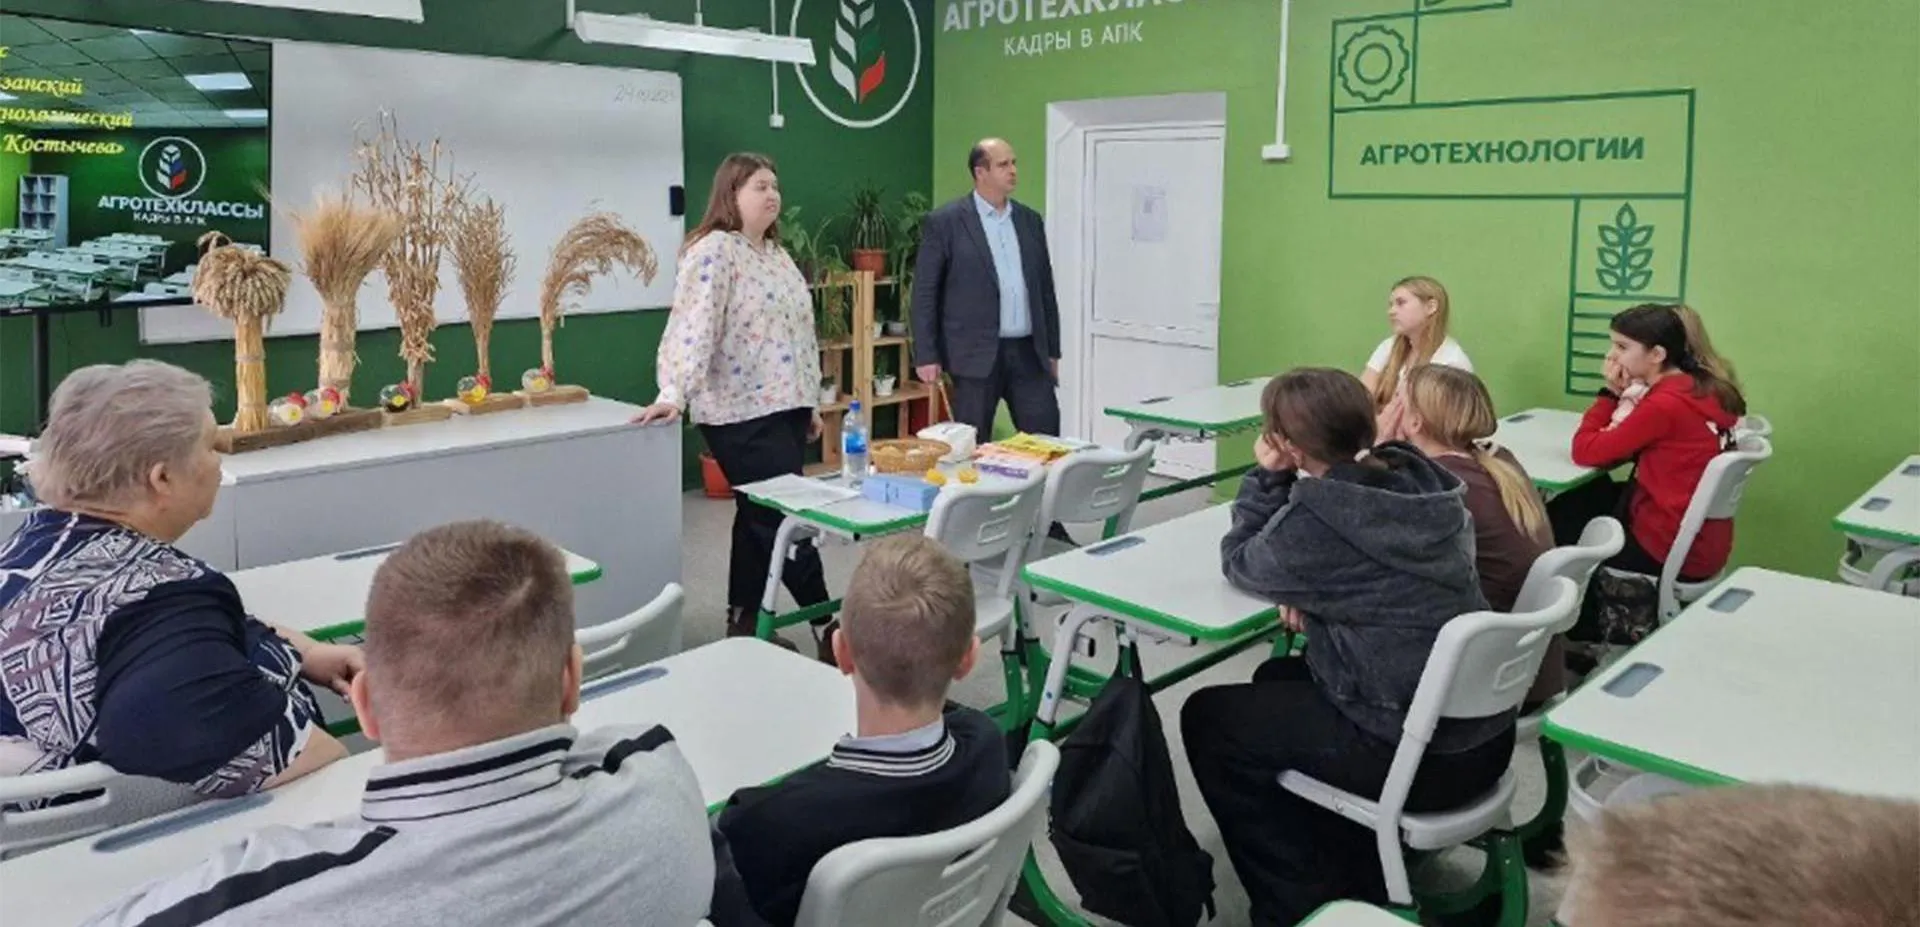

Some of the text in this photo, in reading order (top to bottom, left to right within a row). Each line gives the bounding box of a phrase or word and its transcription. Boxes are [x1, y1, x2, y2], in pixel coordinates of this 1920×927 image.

[943, 0, 1181, 32] АГРОТЕХ
[1004, 20, 1143, 57] КАДРЫ В АПК
[1360, 137, 1644, 165] АГРОТЕХНОЛОГИИ
[98, 195, 264, 219] АГРОТЕХКЛАССЫ
